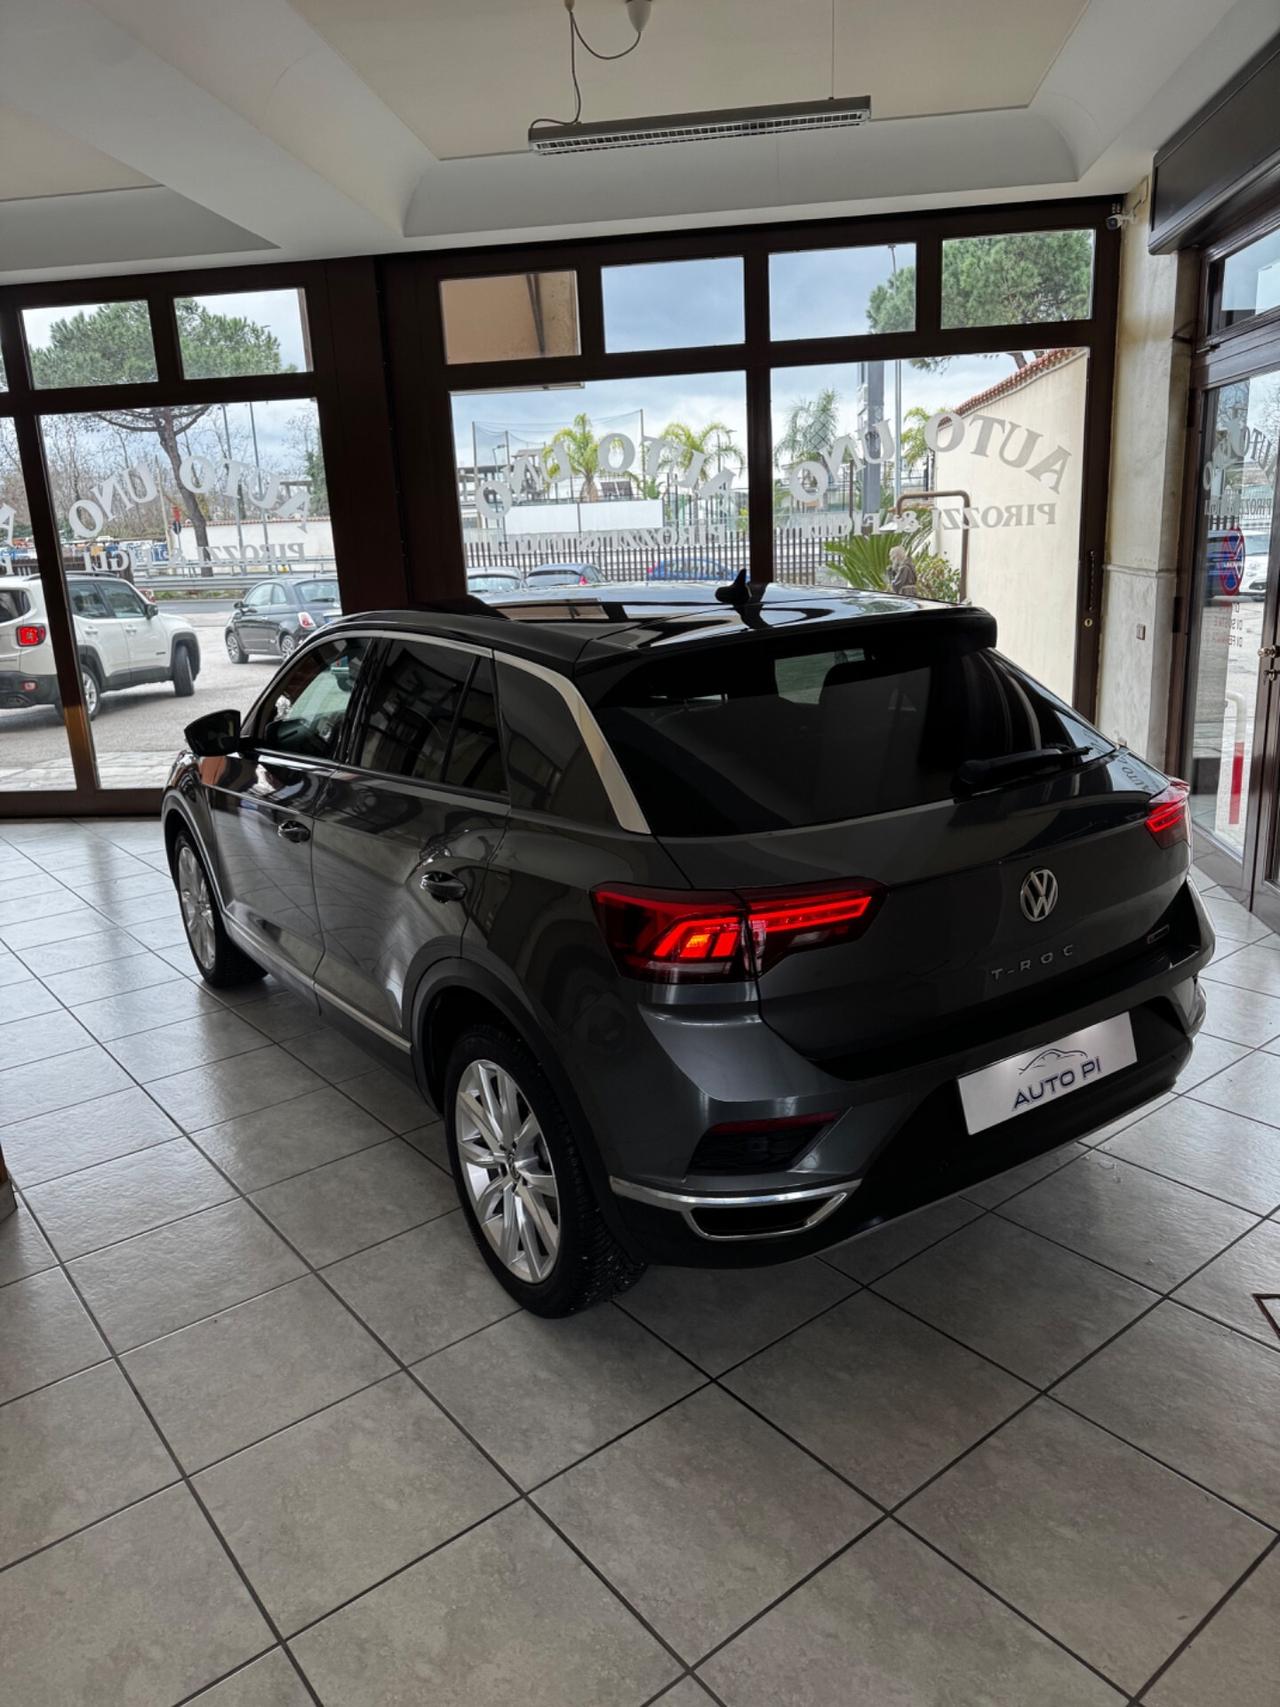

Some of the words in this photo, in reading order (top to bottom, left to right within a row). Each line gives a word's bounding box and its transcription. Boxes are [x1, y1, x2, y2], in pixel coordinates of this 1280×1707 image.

[991, 943, 1074, 981] T-ROC
[1011, 1069, 1076, 1112] AUTO
[1081, 1055, 1102, 1080] PI
